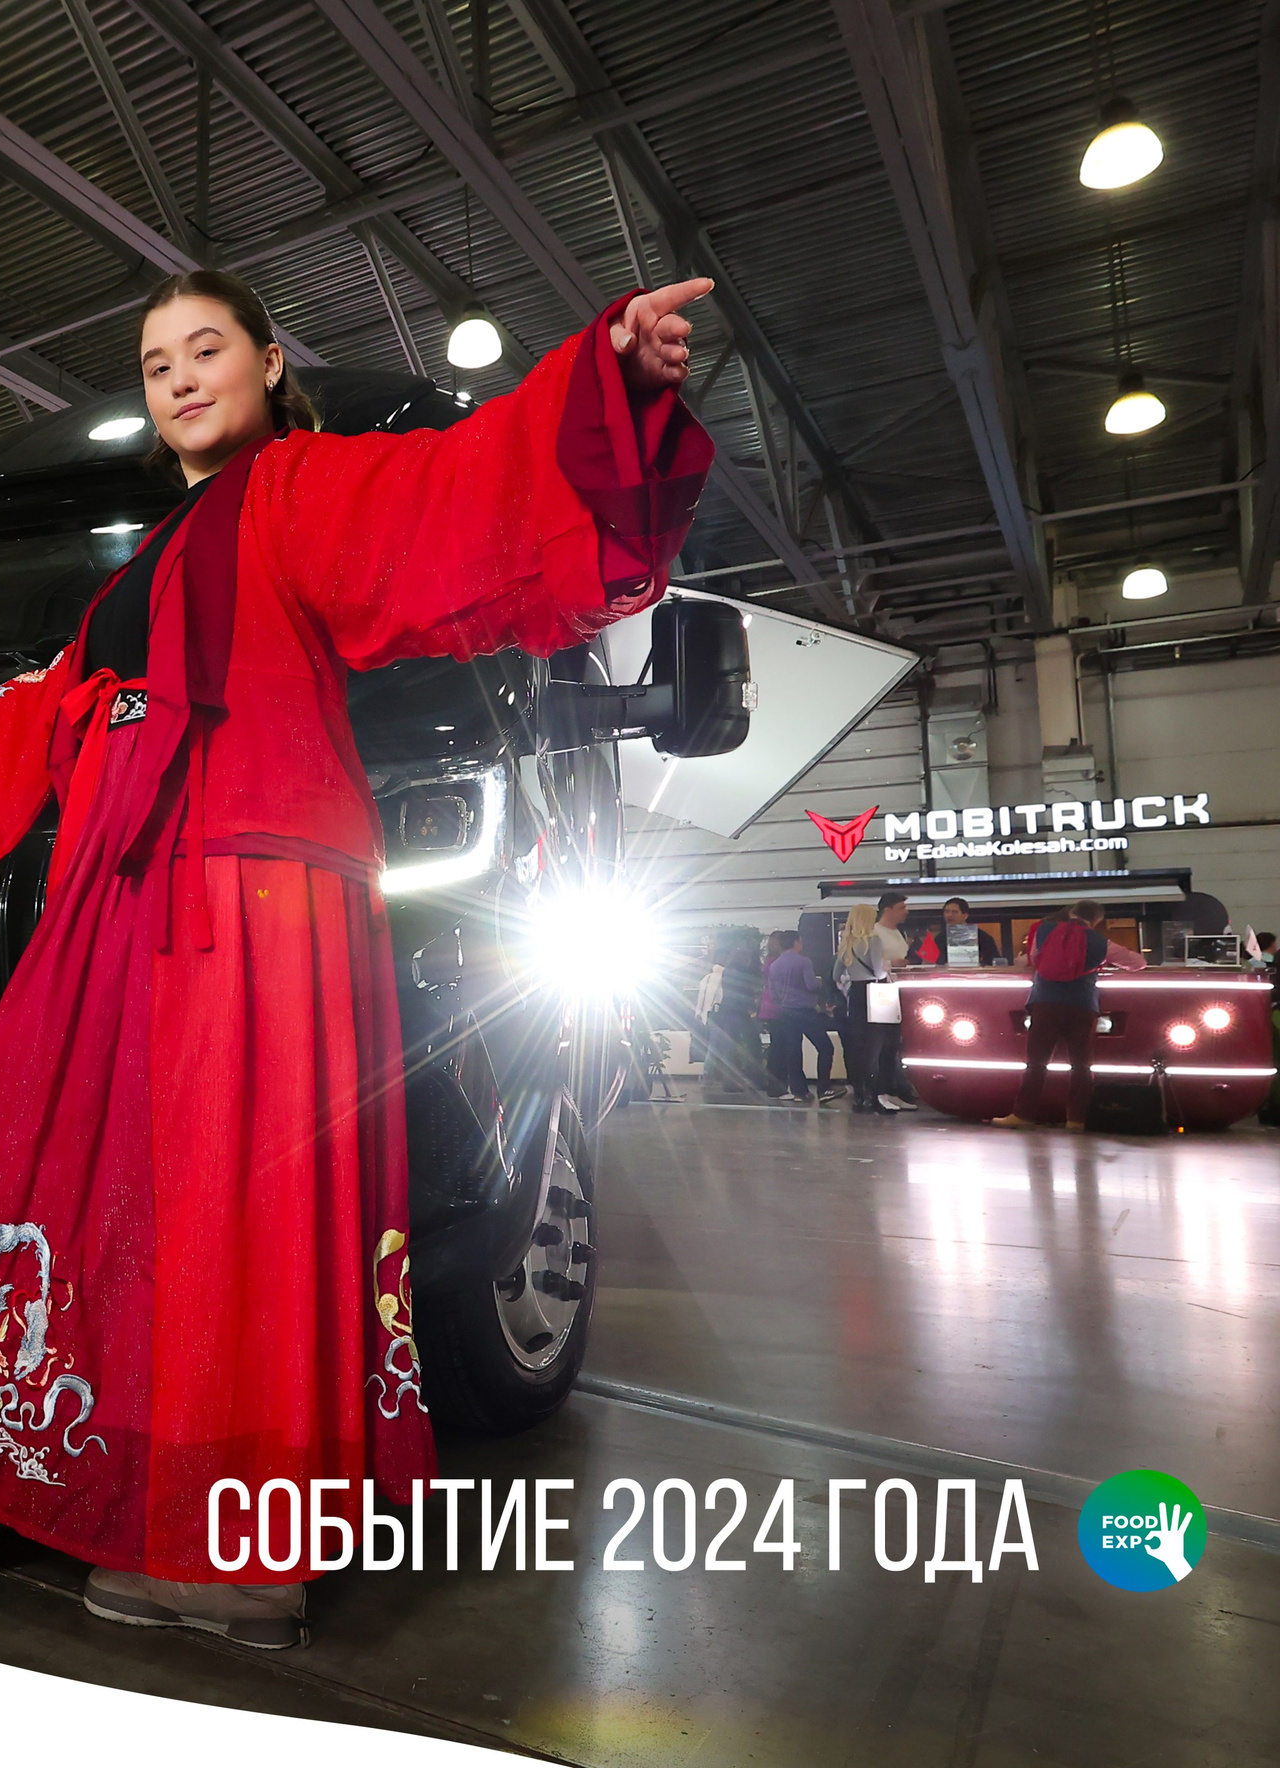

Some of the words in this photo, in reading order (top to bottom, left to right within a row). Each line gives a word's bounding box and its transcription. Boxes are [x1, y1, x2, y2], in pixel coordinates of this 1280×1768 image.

[884, 792, 1210, 843] MOBITRUCK
[884, 846, 911, 863] by
[916, 836, 1129, 861] EdaNaKolesah.com
